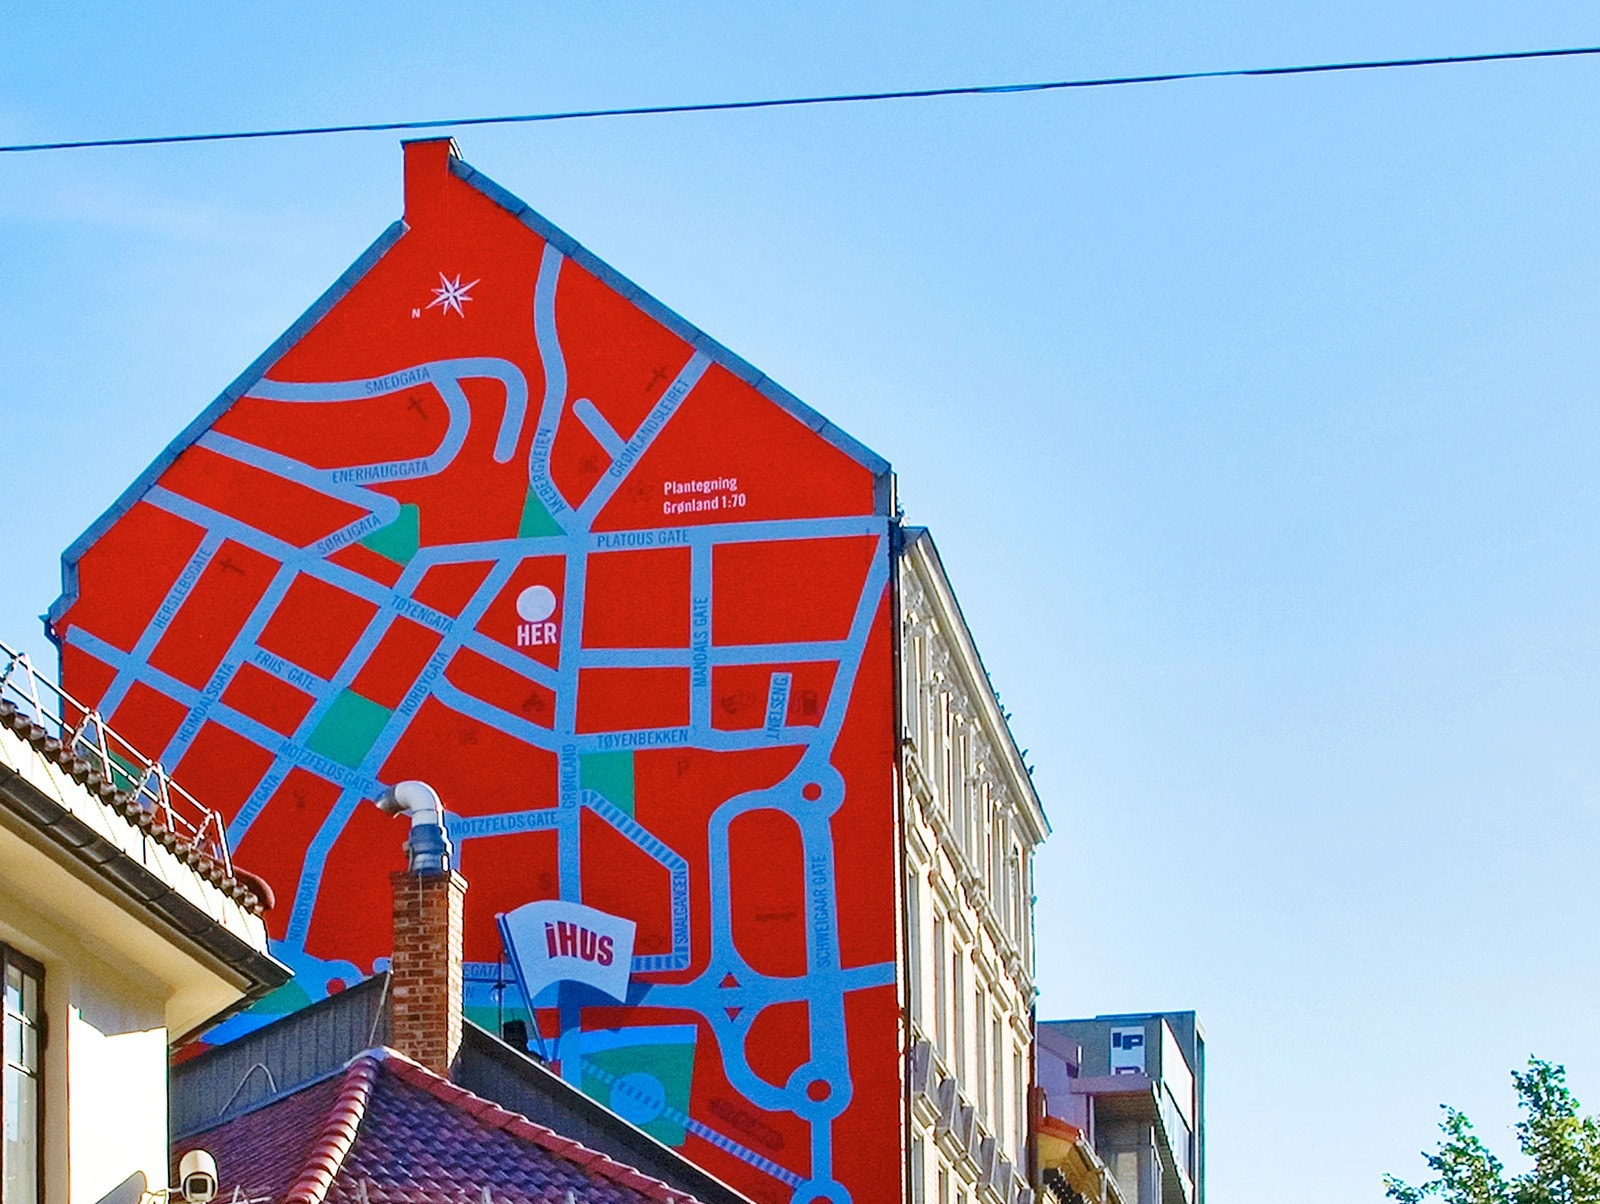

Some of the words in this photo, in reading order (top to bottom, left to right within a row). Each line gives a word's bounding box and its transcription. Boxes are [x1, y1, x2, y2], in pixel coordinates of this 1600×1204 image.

[411, 308, 421, 318] N
[365, 367, 431, 394] SMEDGATA
[609, 378, 690, 478] GRØNLANDSLEIRET
[332, 460, 430, 484] ENERHAUGGATA
[664, 477, 738, 496] Plantegning
[663, 496, 719, 515] Grønland
[721, 493, 746, 508] 1:70
[316, 514, 382, 556] SØRLIGATA
[597, 531, 654, 548] PLATOUS
[658, 529, 690, 544] GATE
[153, 547, 213, 630] HERSLEBSGATE
[390, 594, 454, 632] TØYENGATA
[694, 597, 708, 627] GATE
[517, 622, 558, 647] HER
[254, 650, 284, 674] FRIIS
[287, 667, 317, 691] GATE
[693, 630, 708, 688] MANDALS
[177, 662, 235, 743] HEIMDALSGATA
[598, 728, 689, 750] TØYENBEKKEN
[279, 740, 345, 779] MOTZFELDS
[344, 770, 373, 795] GATE
[562, 744, 577, 809] GRØNLAND
[236, 774, 280, 827] URTEGATA
[526, 810, 559, 827] GATE
[812, 855, 827, 885] GATE
